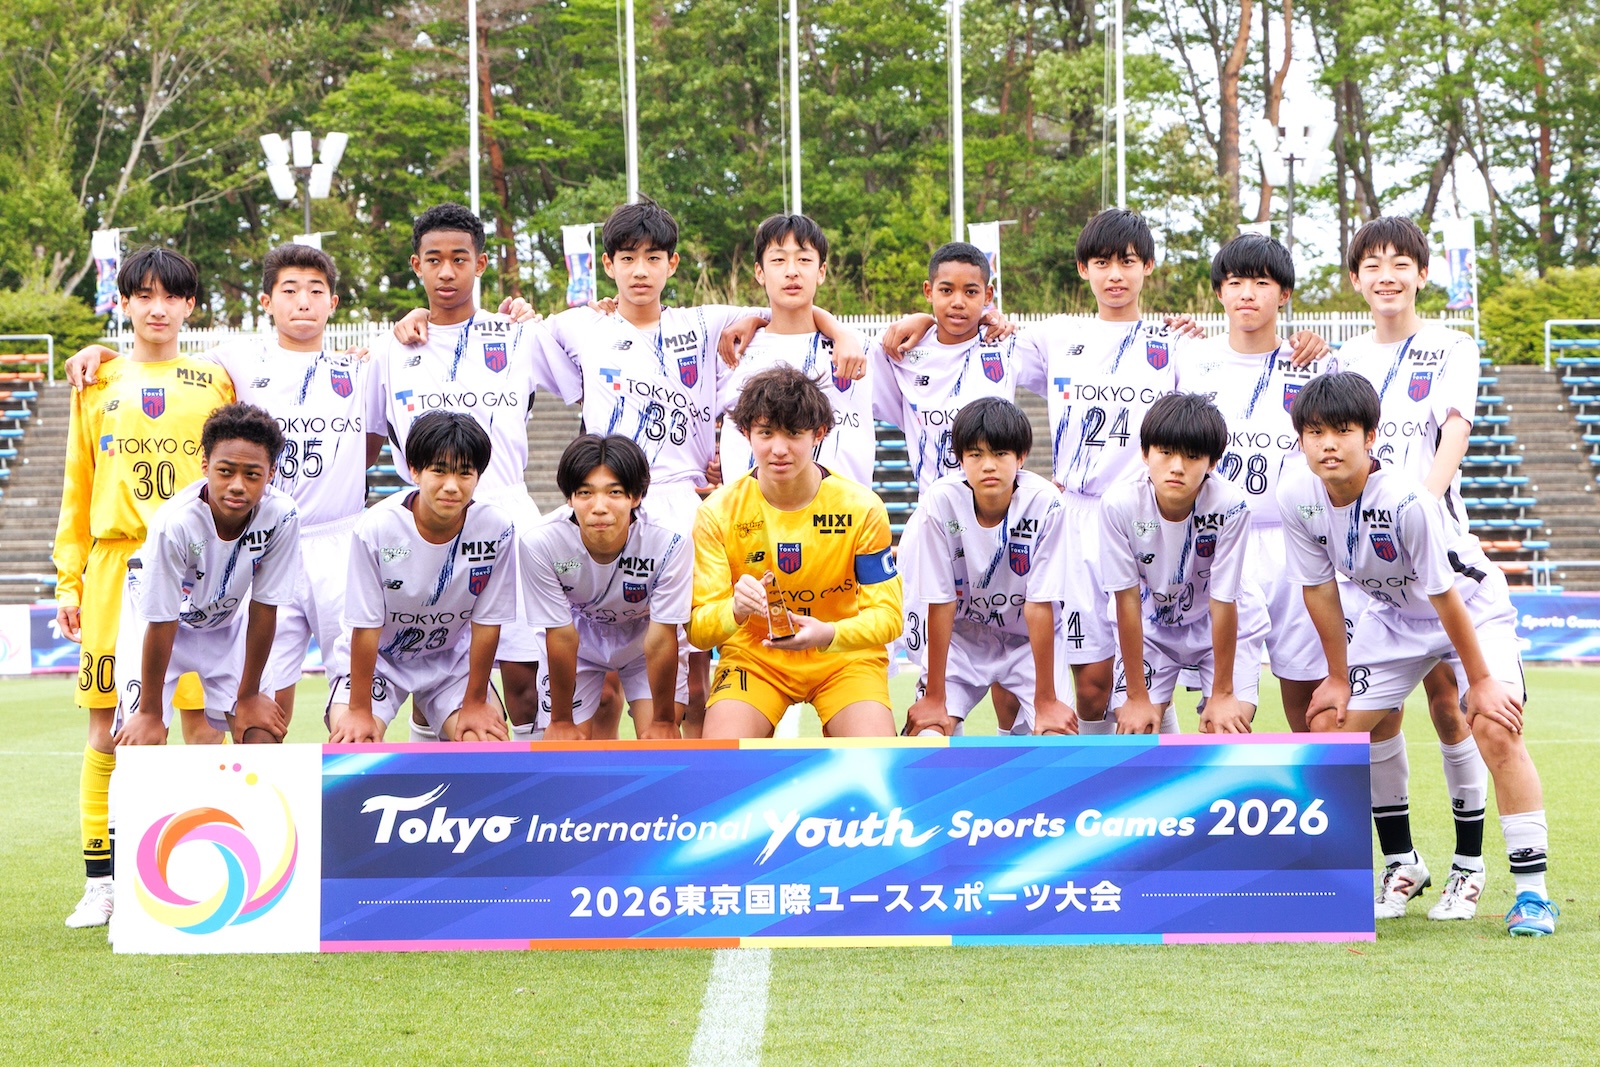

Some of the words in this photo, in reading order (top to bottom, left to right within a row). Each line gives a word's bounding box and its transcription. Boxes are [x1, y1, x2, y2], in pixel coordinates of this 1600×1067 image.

[665, 330, 698, 349] MIXI
[1408, 348, 1444, 362] MIXI
[177, 368, 213, 384] MIXI
[418, 392, 478, 410] TOKYO
[482, 391, 518, 407] GAS
[626, 378, 686, 409] TOKYO
[1075, 385, 1135, 402] TOKYO
[330, 417, 362, 433] GAS
[645, 401, 688, 446] 33
[834, 409, 860, 428] GAS
[921, 408, 960, 426] TOK
[1085, 406, 1131, 447] 24
[1401, 421, 1430, 437] GAS
[116, 438, 177, 454] TOKYO
[1276, 435, 1300, 450] GA
[133, 461, 175, 499] 30
[1222, 452, 1268, 495] 28
[813, 514, 852, 527] MIXI
[243, 526, 276, 546] MIX
[461, 540, 501, 556] MIX
[618, 556, 654, 572] MIXI
[970, 593, 1007, 609] KYO
[389, 611, 455, 625] TOKYO
[1521, 614, 1565, 630] Sports
[400, 627, 449, 650] 23
[907, 611, 927, 651] 3
[1067, 611, 1085, 649] 4
[79, 652, 116, 693] 30
[360, 782, 523, 855] Tokyo
[526, 813, 750, 843] International
[753, 805, 944, 867] Youth
[946, 809, 1065, 846] Sports
[1074, 808, 1196, 838] Games
[1207, 797, 1330, 836] 2026
[569, 879, 1122, 918] 2026東京国際ユーススポーツ大会
